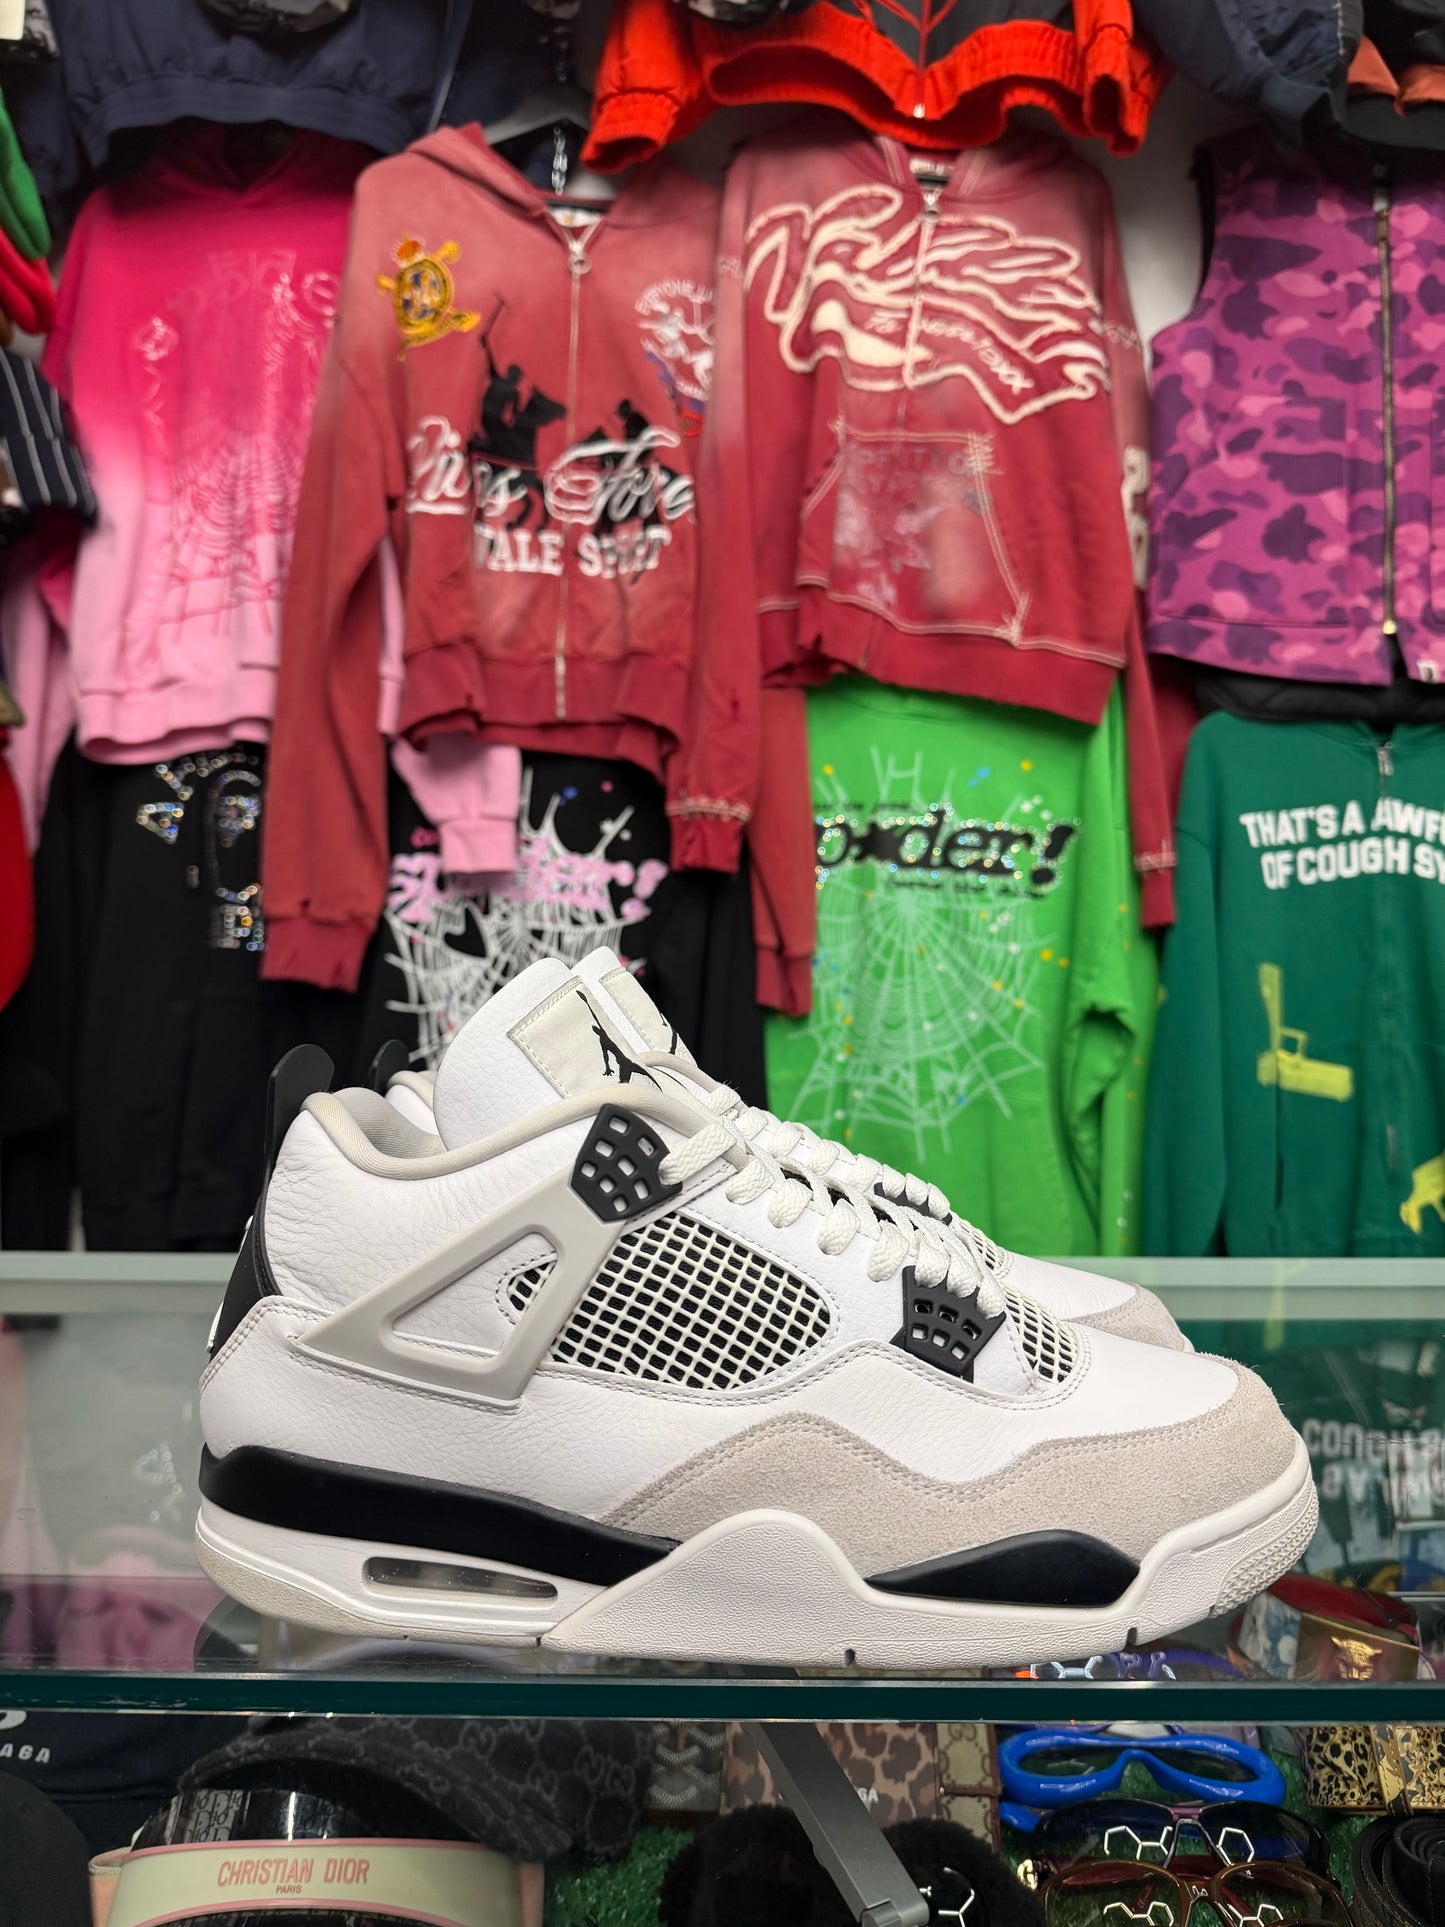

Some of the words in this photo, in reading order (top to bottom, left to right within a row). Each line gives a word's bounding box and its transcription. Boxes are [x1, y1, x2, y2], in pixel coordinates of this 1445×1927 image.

[1239, 804, 1340, 848] THAT'S
[1341, 800, 1366, 836] A
[1370, 797, 1445, 846] AWF
[1260, 850, 1296, 890] OF
[1296, 836, 1411, 885] COUGH
[217, 1858, 314, 1887] CHRISTIAN
[323, 1858, 370, 1884] DIOR
[275, 1885, 302, 1894] PARIS
